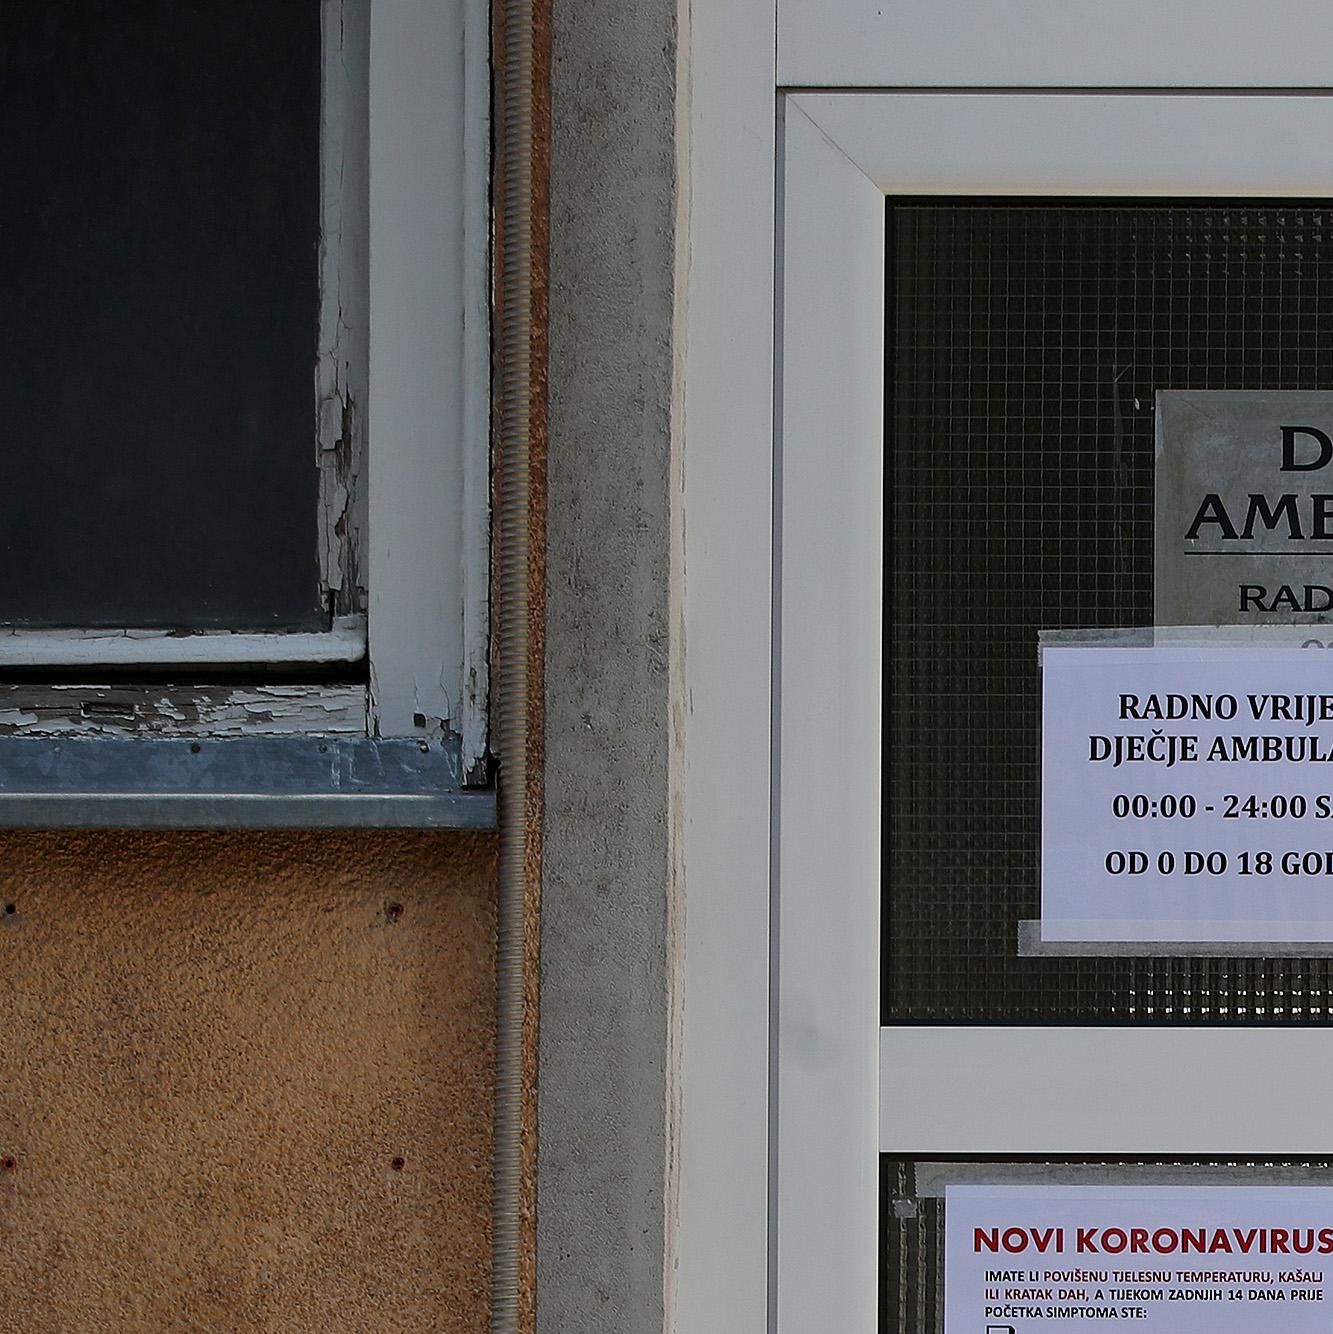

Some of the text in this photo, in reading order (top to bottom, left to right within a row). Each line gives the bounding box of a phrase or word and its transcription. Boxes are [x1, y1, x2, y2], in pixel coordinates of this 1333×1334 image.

[1118, 694, 1238, 720] RADNO
[1088, 728, 1198, 768] DJEČJE
[1112, 794, 1196, 818] 00:00
[1222, 794, 1307, 819] 24:00
[1105, 851, 1149, 875] OD
[1157, 851, 1175, 875] 0
[1183, 851, 1227, 875] DO
[1237, 851, 1273, 876] 18
[974, 1227, 1064, 1254] NOVI
[985, 1268, 1323, 1285] IMATE LI POVIŠENU TJELESNU TEMPERATURU, KAŠALJ
[985, 1303, 1147, 1319] POČETKA SIMPTOMA STE:
